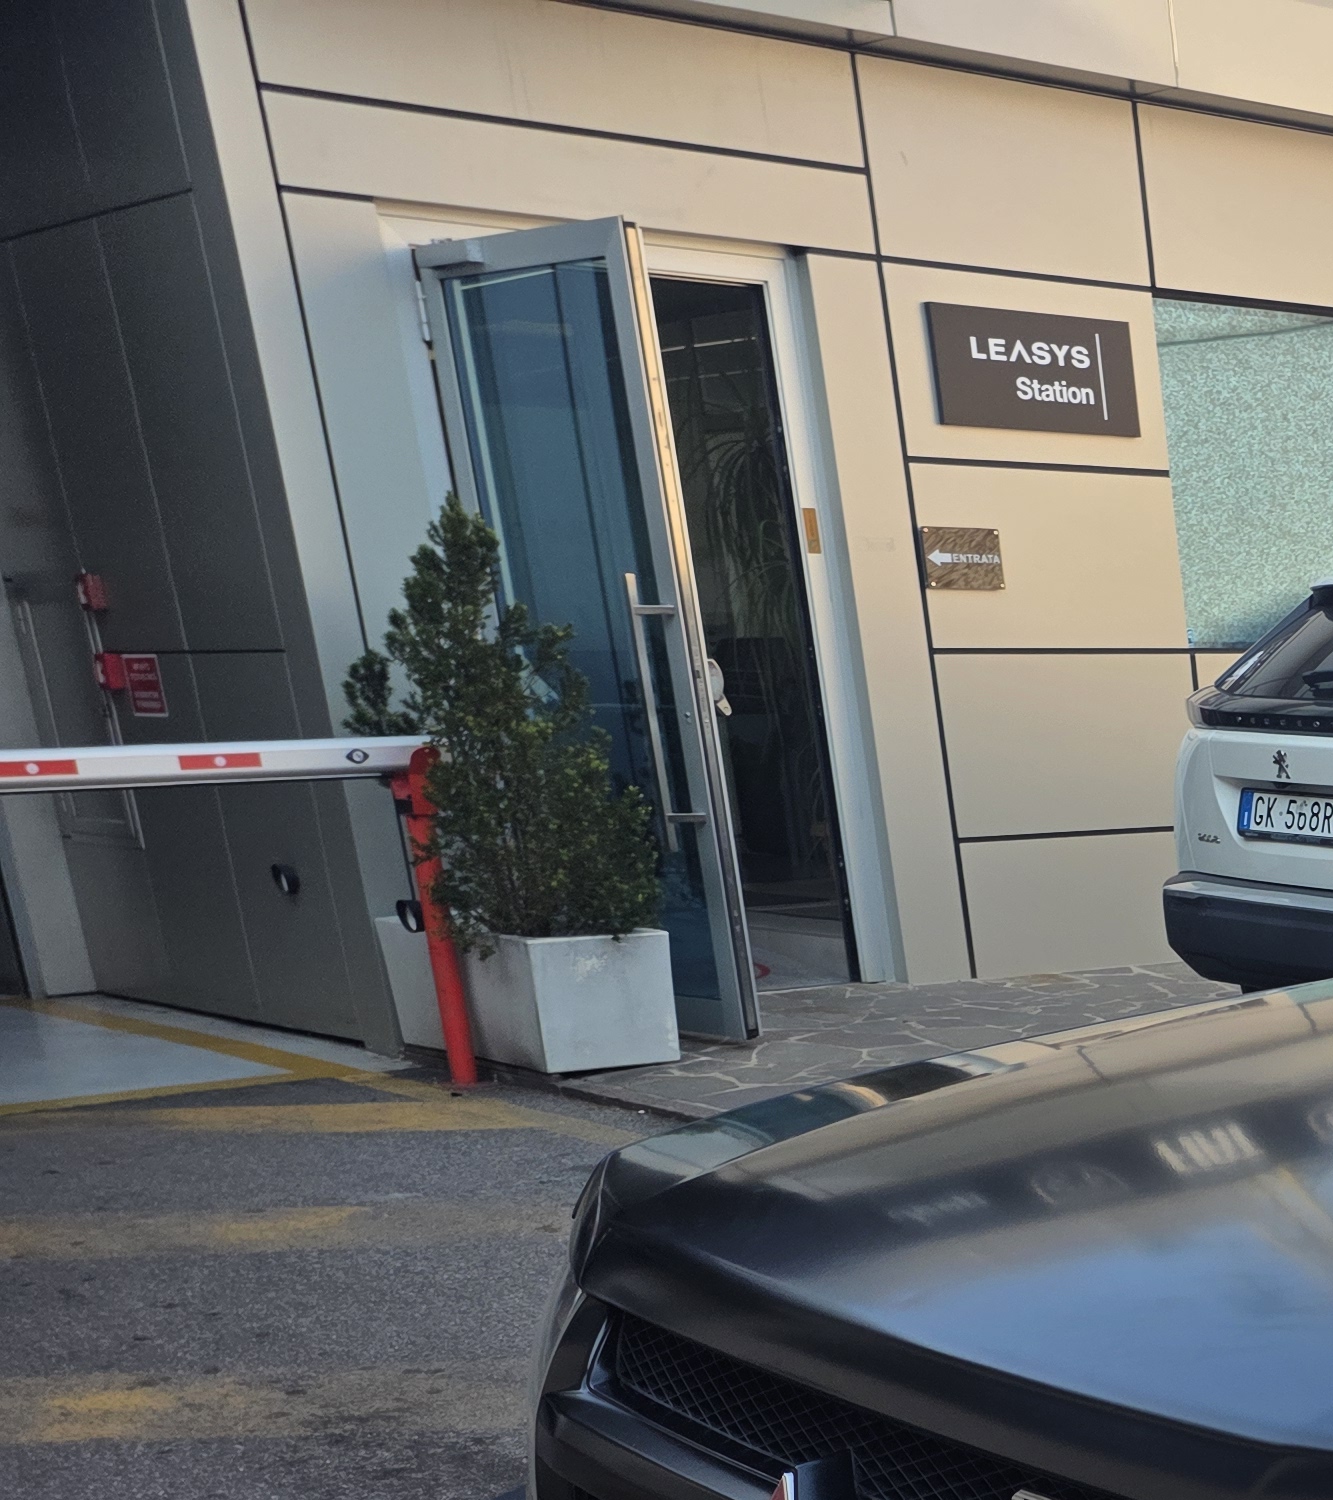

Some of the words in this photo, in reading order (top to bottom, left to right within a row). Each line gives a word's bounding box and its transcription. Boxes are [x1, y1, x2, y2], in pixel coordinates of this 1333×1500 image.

[969, 336, 1091, 369] LEASYS
[1016, 376, 1095, 405] Station
[952, 553, 1001, 565] ENTRATA
[1254, 796, 1278, 828] GK
